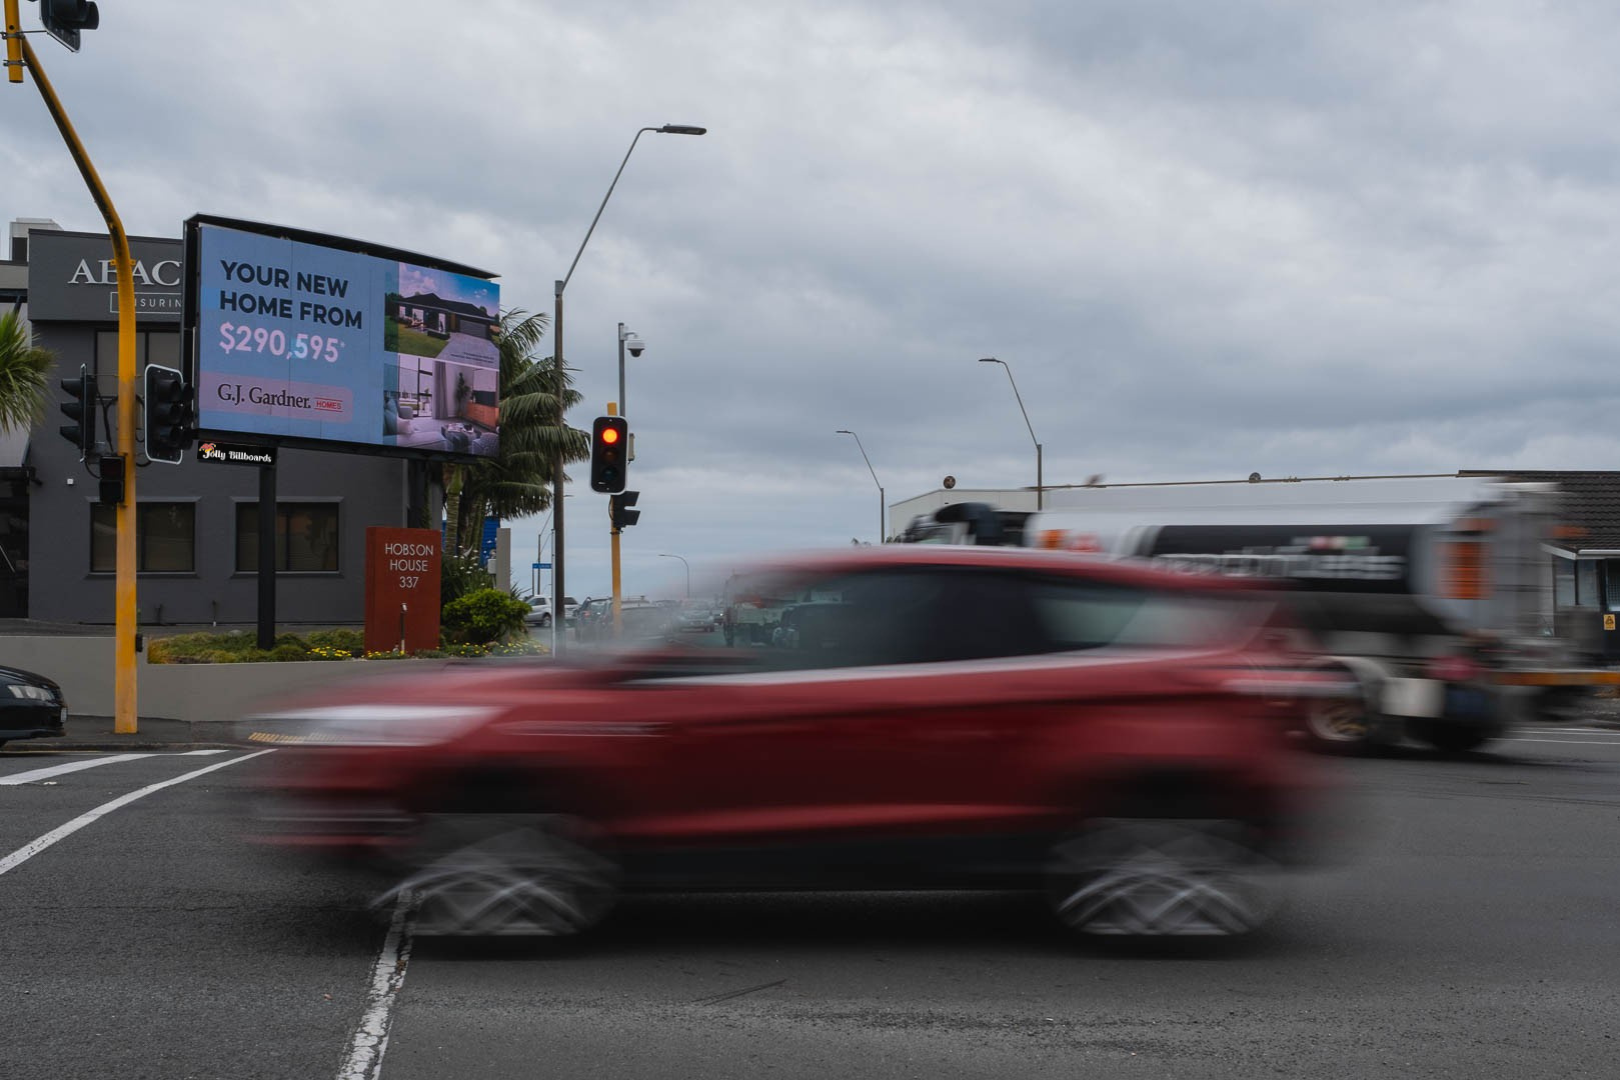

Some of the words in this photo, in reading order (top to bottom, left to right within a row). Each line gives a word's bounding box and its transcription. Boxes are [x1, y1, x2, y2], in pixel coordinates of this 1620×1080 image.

[220, 260, 290, 289] YOUR
[296, 271, 349, 298] NEW
[220, 290, 293, 319] HOME
[299, 301, 363, 330] FROM
[217, 383, 245, 406] G.J.
[316, 400, 342, 410] HOMES
[202, 449, 226, 460] Jolly
[228, 451, 272, 463] Billboards
[385, 543, 434, 556] HOBSON
[390, 559, 429, 572] HOUSE
[399, 576, 419, 588] 337
